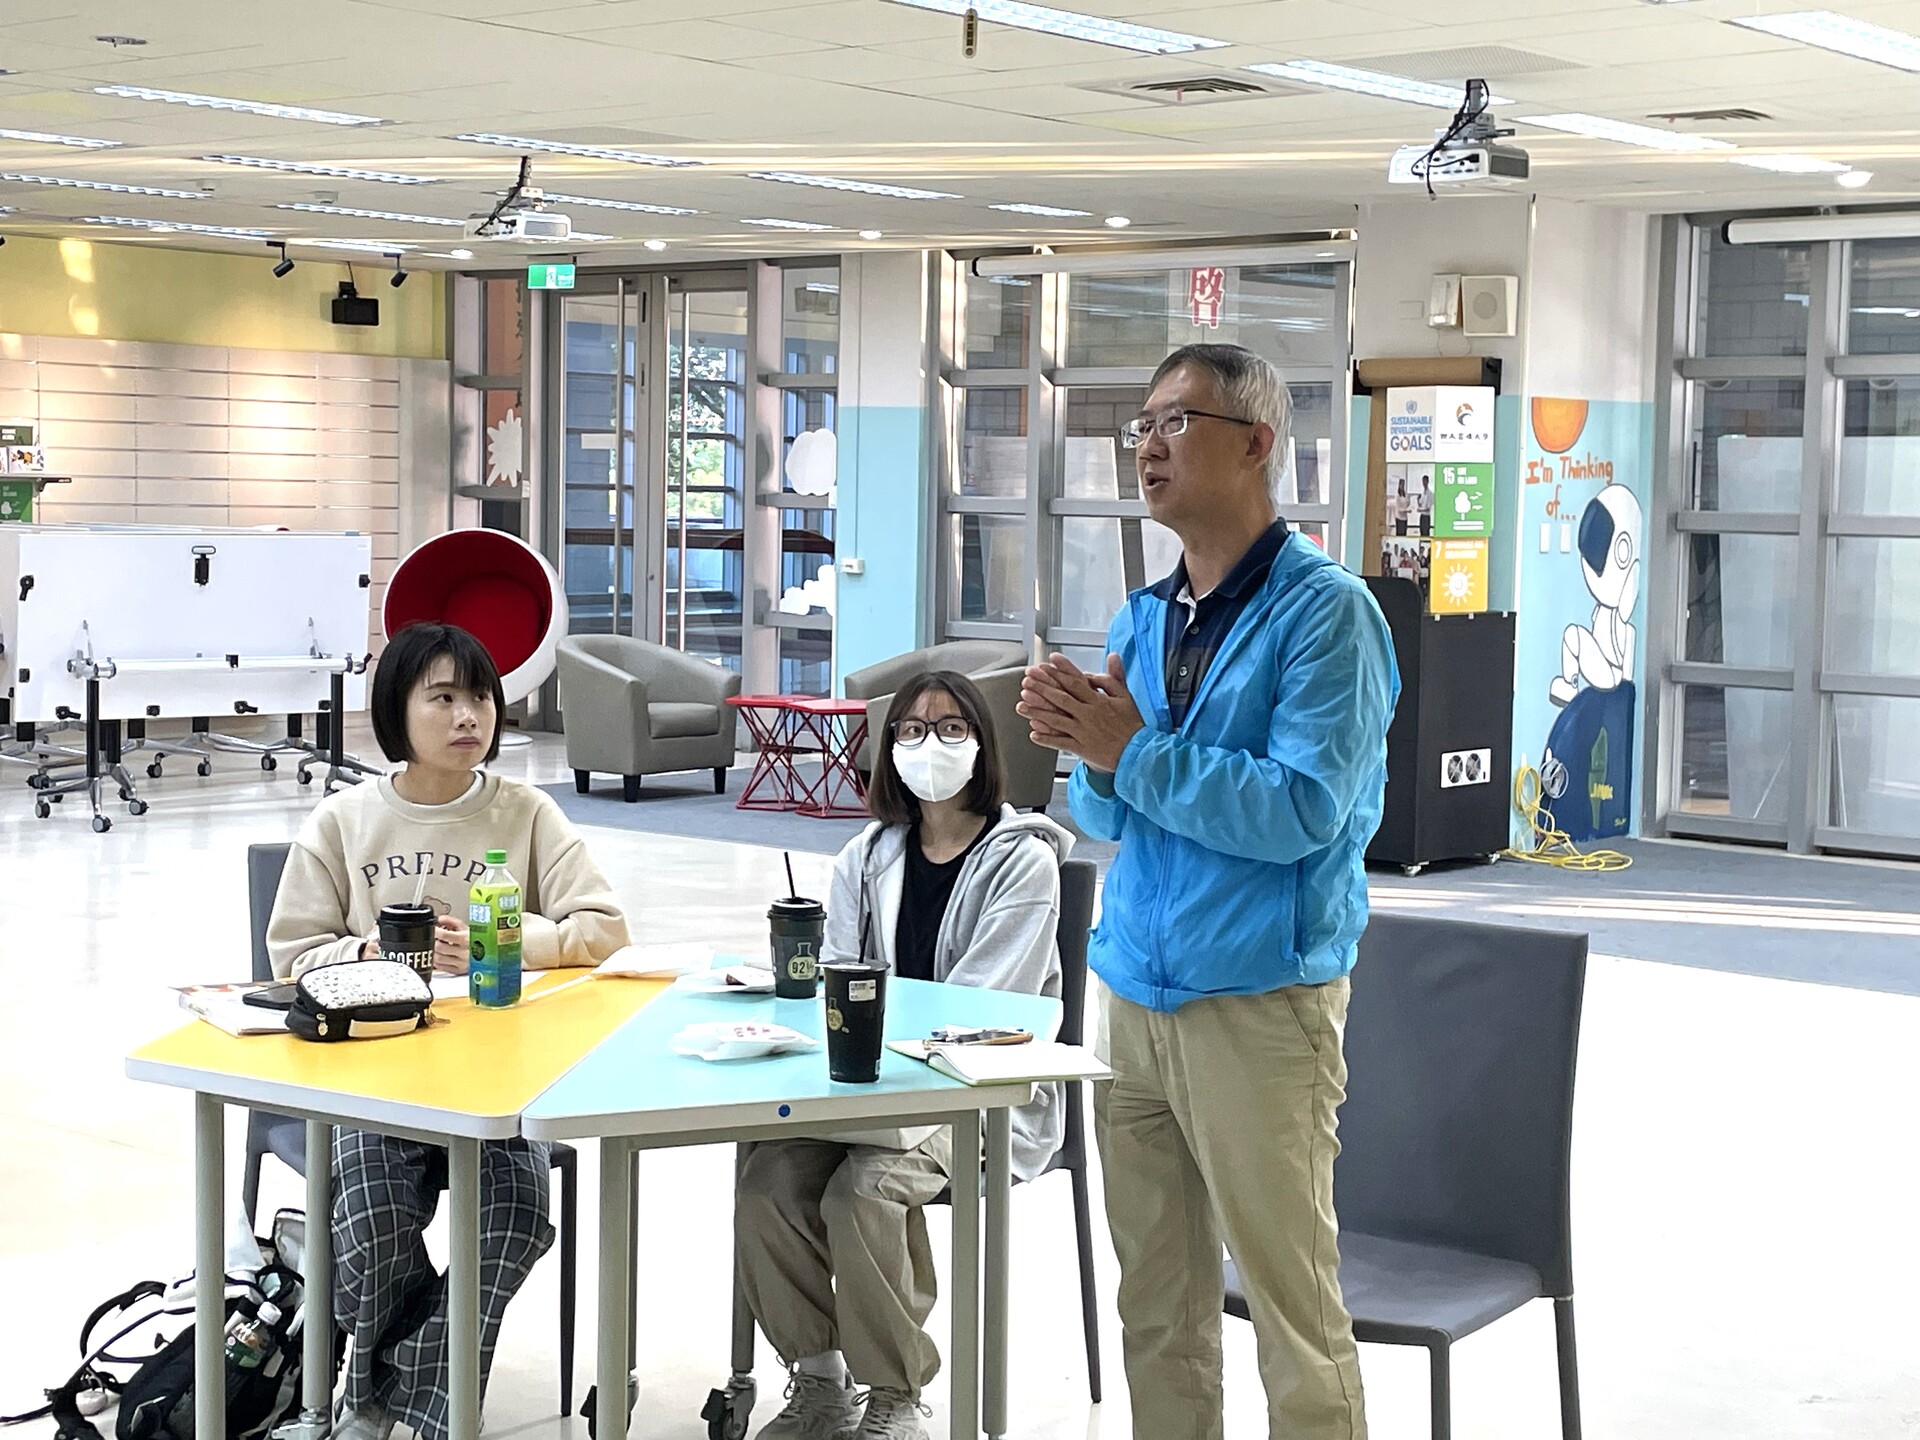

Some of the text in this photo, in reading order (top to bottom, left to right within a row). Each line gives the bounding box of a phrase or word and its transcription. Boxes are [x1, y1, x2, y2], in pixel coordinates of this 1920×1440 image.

[1390, 415, 1433, 425] SUSTAINABLE
[1390, 426, 1432, 435] DEVELOPMENT
[1390, 435, 1432, 451] GOALS
[1443, 466, 1455, 485] 15
[1525, 451, 1613, 486] I'm Thinking
